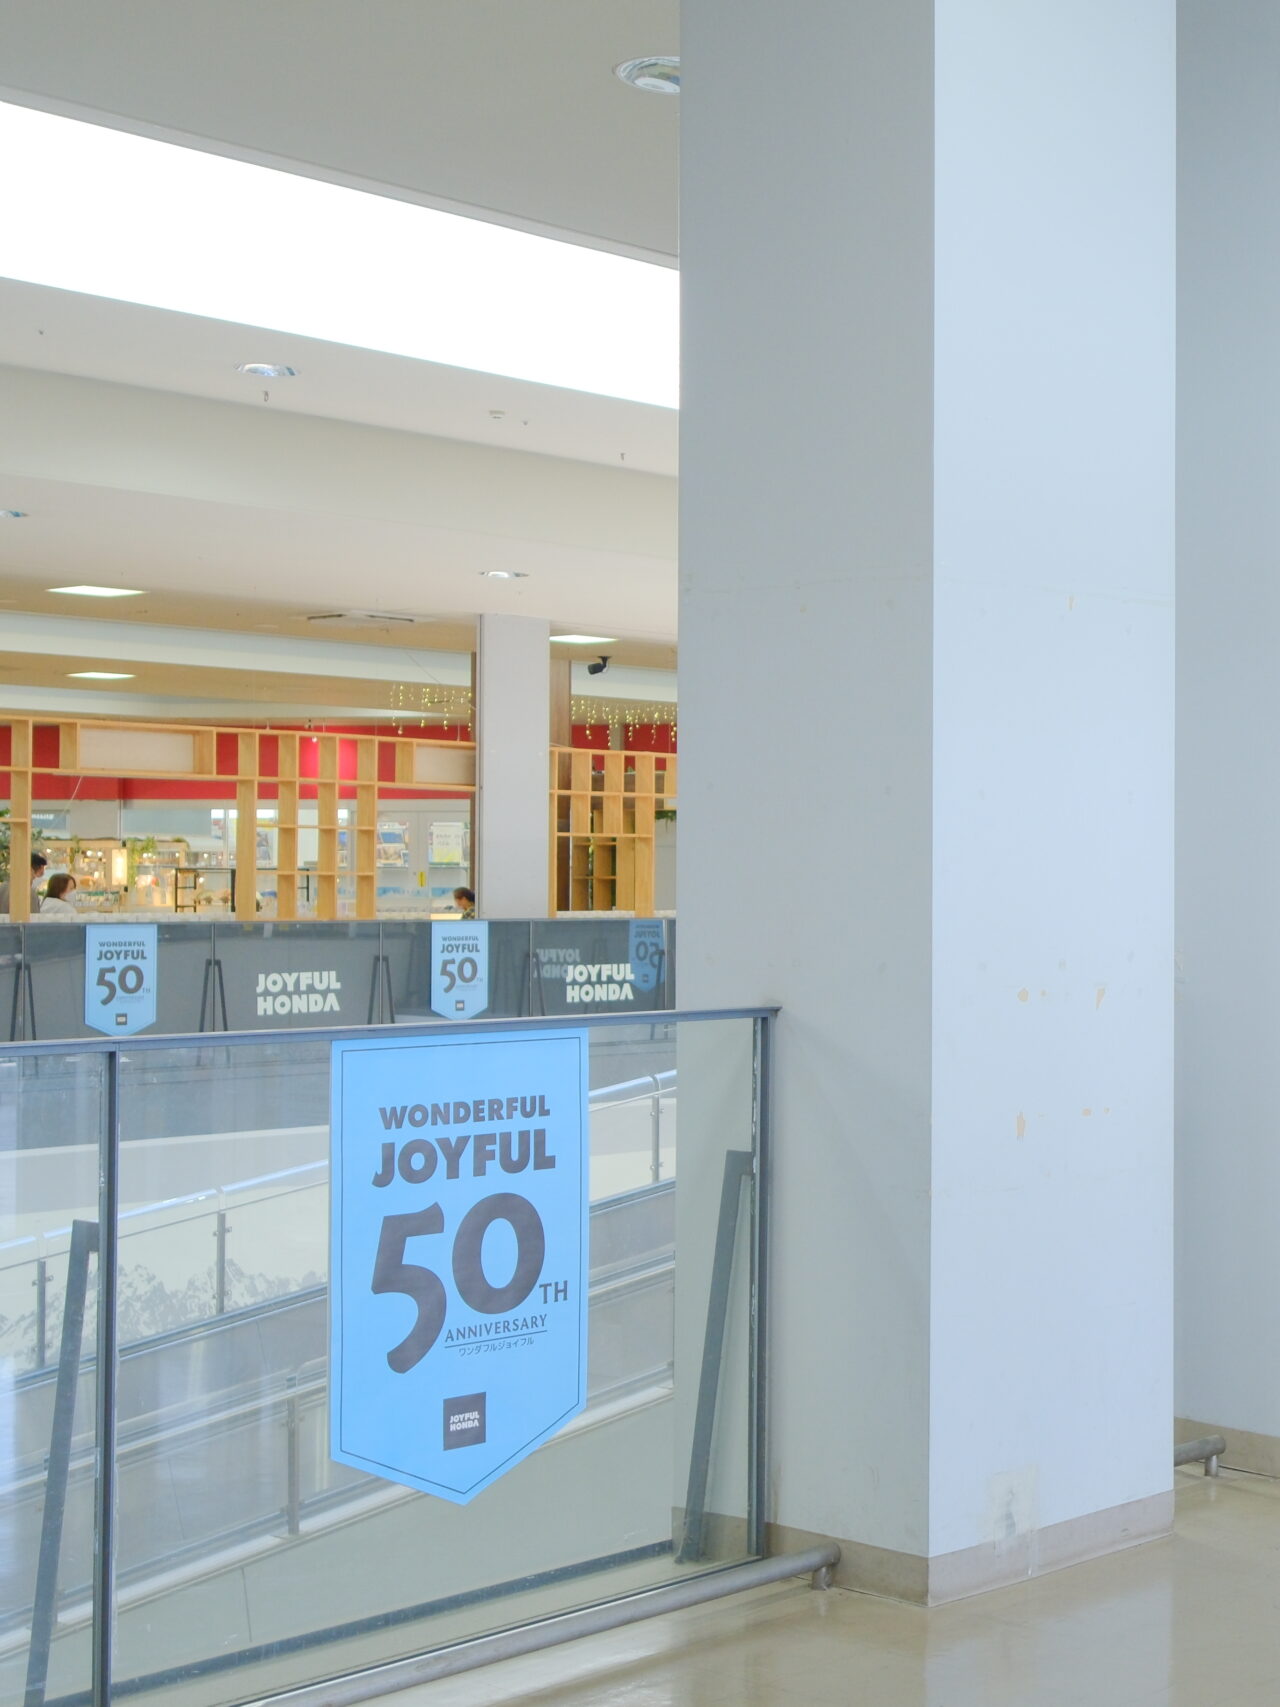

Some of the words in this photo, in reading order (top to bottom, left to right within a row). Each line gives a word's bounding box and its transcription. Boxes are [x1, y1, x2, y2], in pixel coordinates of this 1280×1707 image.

[97, 949, 147, 961] JOYFUL
[440, 943, 480, 954] JOYFUL
[256, 970, 341, 994] JOYFUL
[439, 957, 478, 993] 50
[566, 963, 635, 983] JOYFUL
[96, 965, 144, 1006] 50
[566, 983, 634, 1003] HONDA
[257, 993, 341, 1016] HONDA
[379, 1095, 551, 1131] WONDERFUL
[371, 1127, 556, 1188] JOYFUL
[370, 1192, 546, 1375] 50
[539, 1279, 569, 1304] TH
[444, 1313, 548, 1343] ANNIVERSARY
[458, 1337, 535, 1357] ワンダフルジョイフル
[450, 1411, 480, 1424] JOYFUL
[450, 1419, 480, 1432] HONDA
